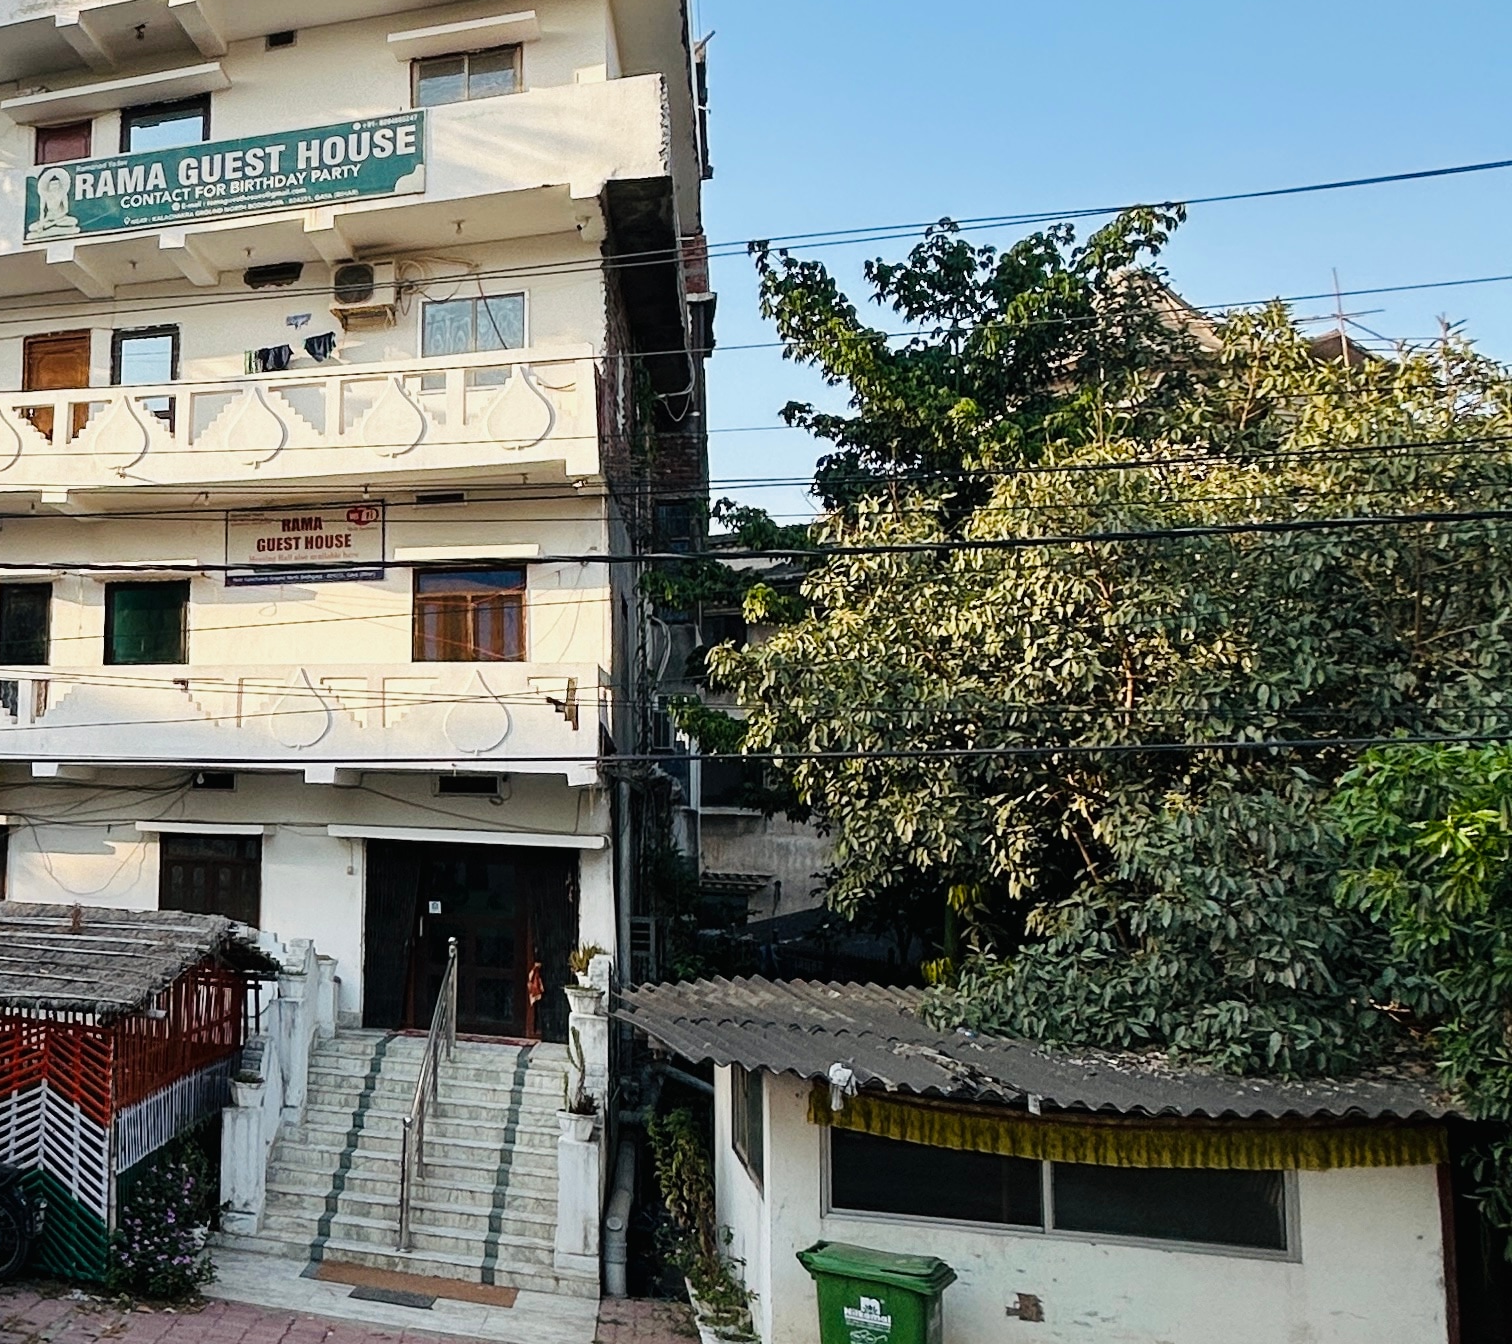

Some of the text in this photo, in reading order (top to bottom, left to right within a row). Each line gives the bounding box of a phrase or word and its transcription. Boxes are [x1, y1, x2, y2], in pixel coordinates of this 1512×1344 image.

[74, 124, 417, 201] RAMA GUEST HOUSE
[120, 164, 362, 209] CONTACT FOR BIRTHDAY PARTY
[281, 517, 324, 532] RAMA
[256, 534, 352, 552] GUEST HOUSE
